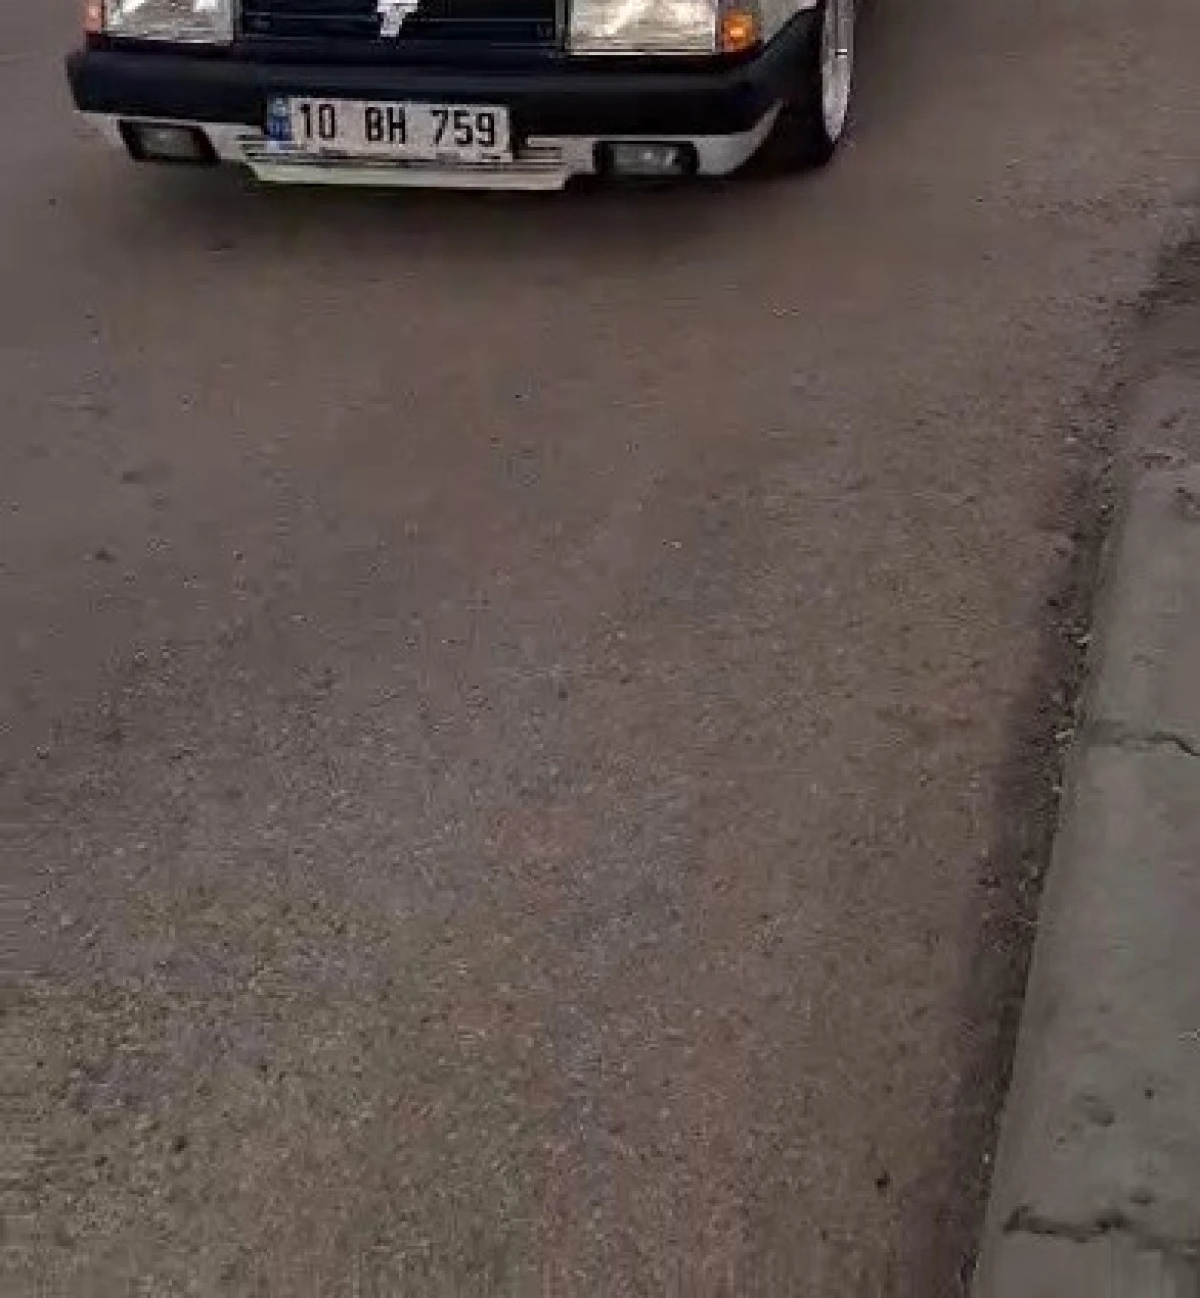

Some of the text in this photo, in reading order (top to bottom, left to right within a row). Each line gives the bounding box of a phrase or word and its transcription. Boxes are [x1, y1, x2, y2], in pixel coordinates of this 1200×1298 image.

[300, 103, 336, 139] 10
[365, 106, 407, 145] BH
[432, 109, 496, 149] 759
